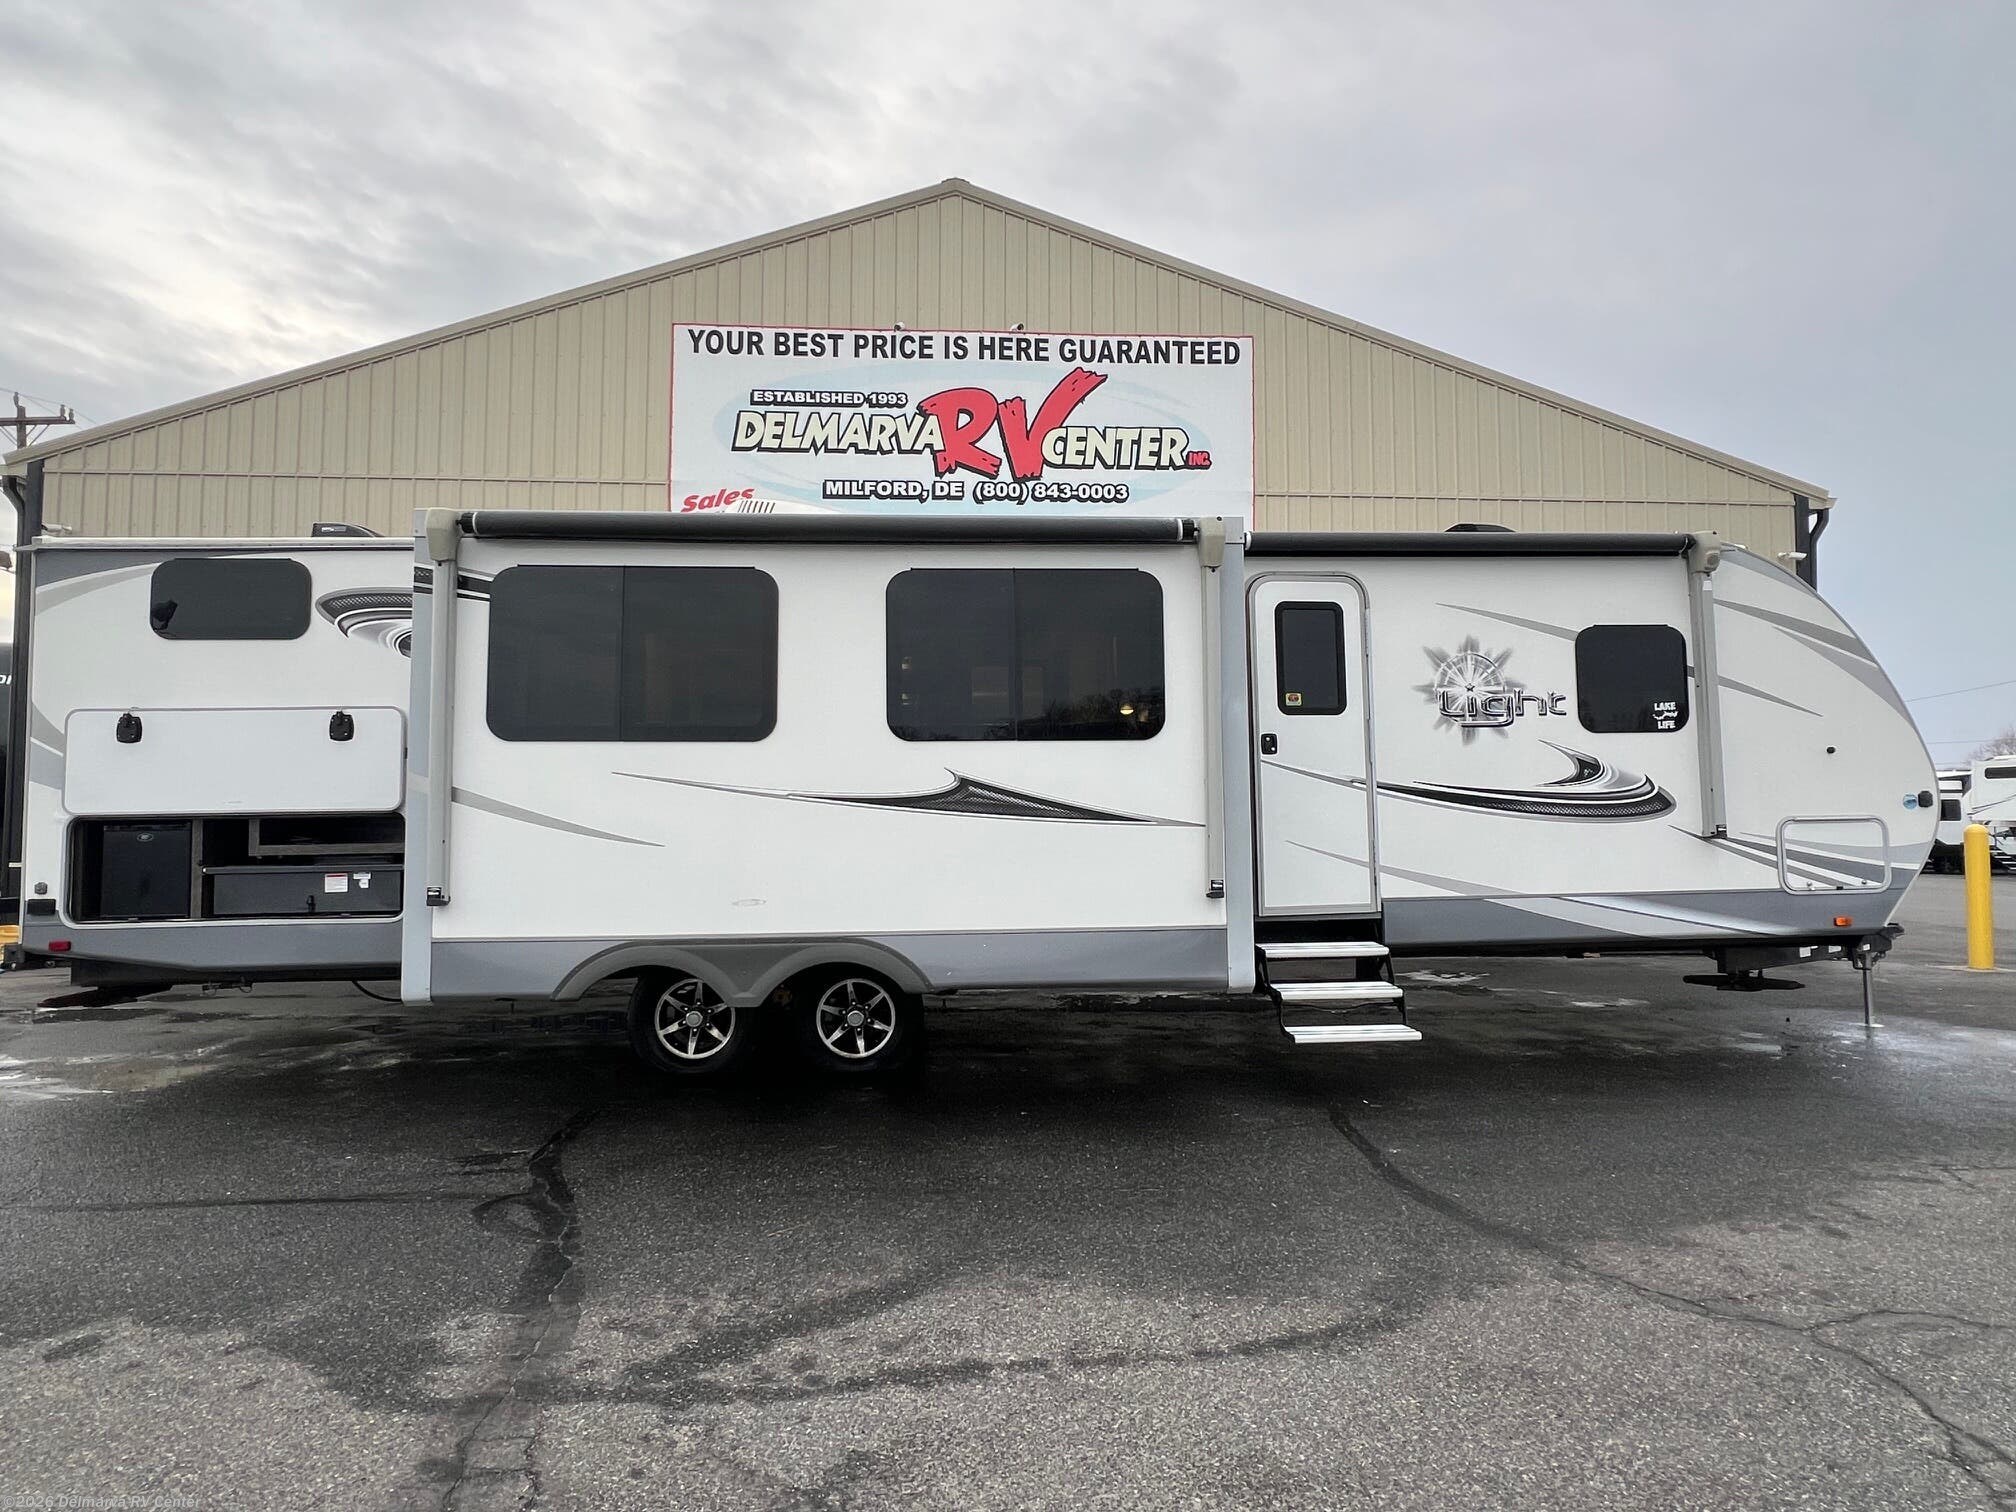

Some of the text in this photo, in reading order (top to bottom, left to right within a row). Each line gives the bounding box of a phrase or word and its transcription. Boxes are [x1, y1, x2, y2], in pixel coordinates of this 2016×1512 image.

[688, 329, 1241, 365] YOUR BEST PRICE IS HERE GUARANTEED
[751, 390, 908, 407] ESTABLISHED 1993
[732, 410, 945, 454] DELMARVA
[917, 367, 1108, 481] RV
[1042, 426, 1189, 470] CENTER
[823, 480, 1130, 505] MILFORD, DE (800) 843-0003
[1437, 688, 1567, 728] Light
[1654, 701, 1677, 711] LAKE
[1657, 720, 1676, 729] LIFE
